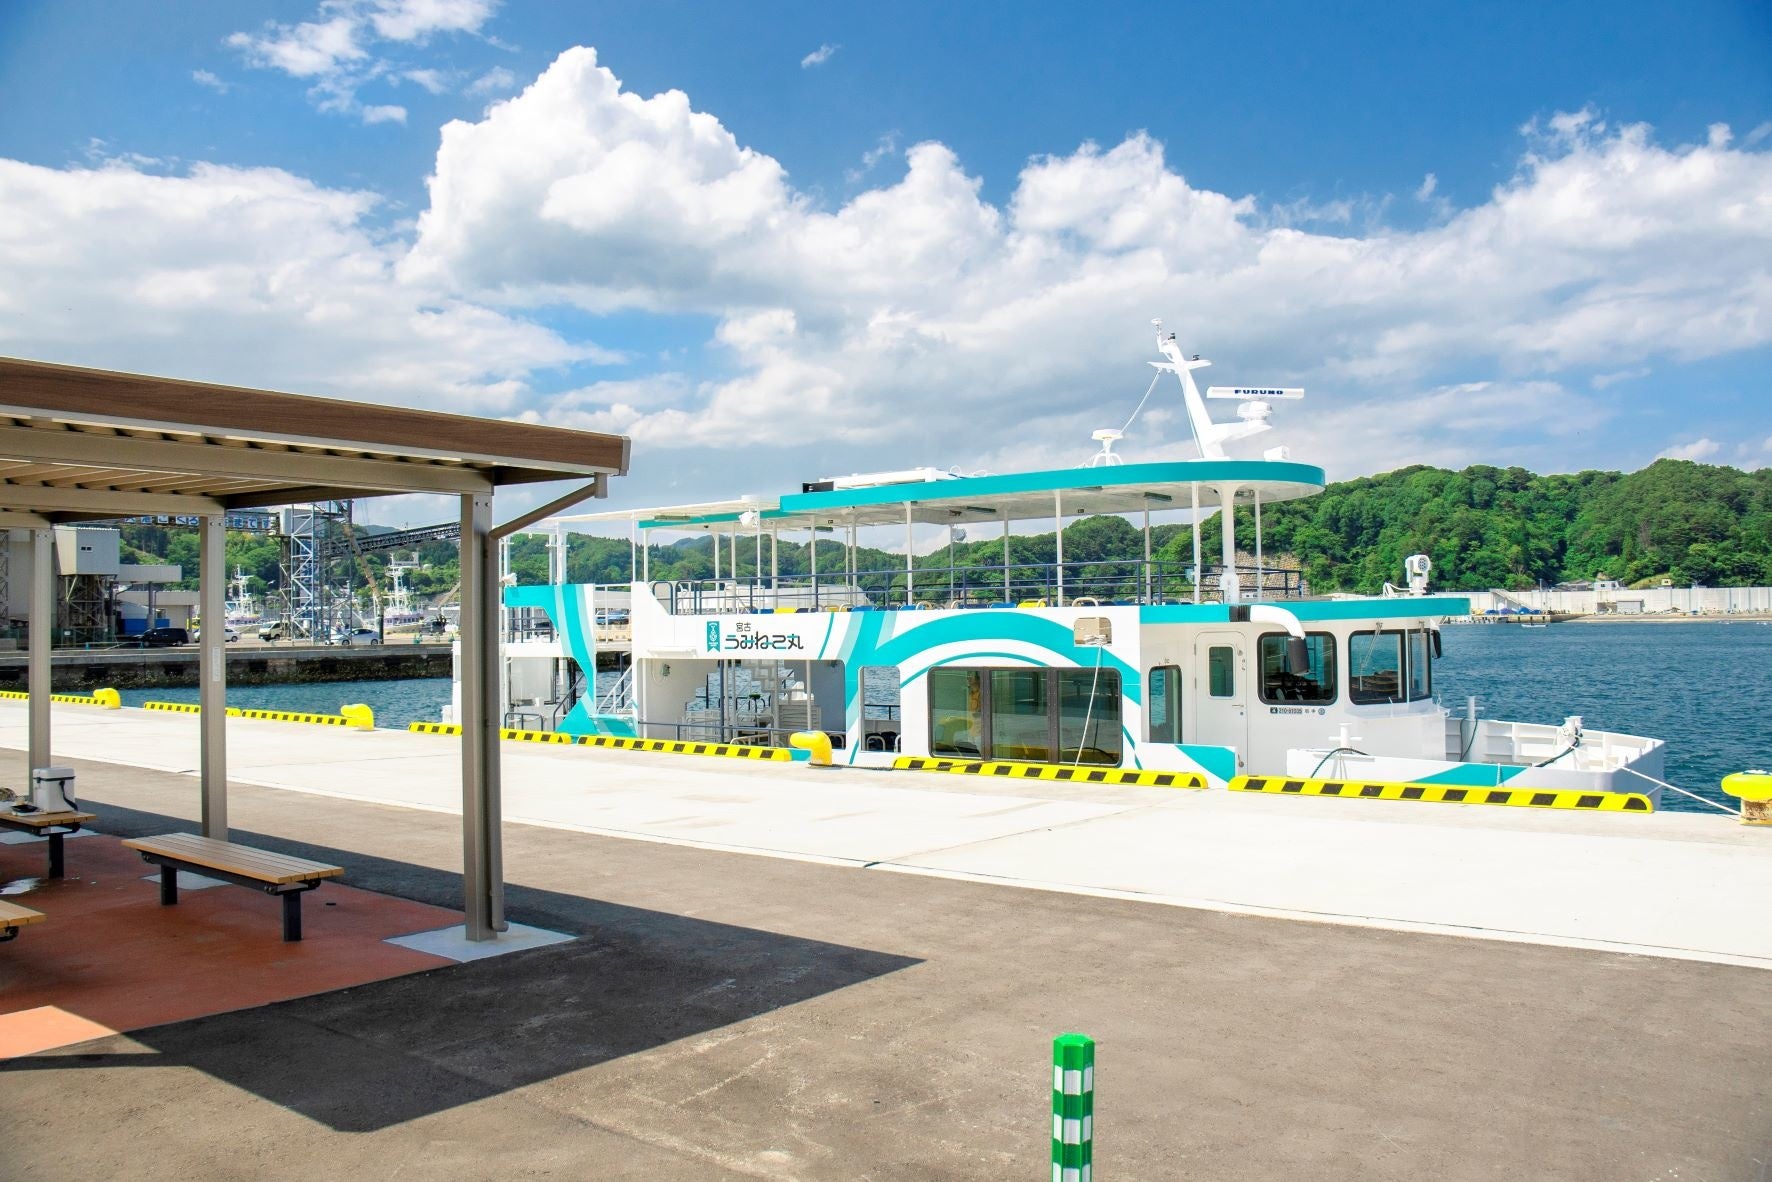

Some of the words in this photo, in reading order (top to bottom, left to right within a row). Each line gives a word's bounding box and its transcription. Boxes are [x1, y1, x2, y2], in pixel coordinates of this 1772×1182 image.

[736, 622, 751, 632] 宮古
[724, 631, 804, 649] うみねこ丸
